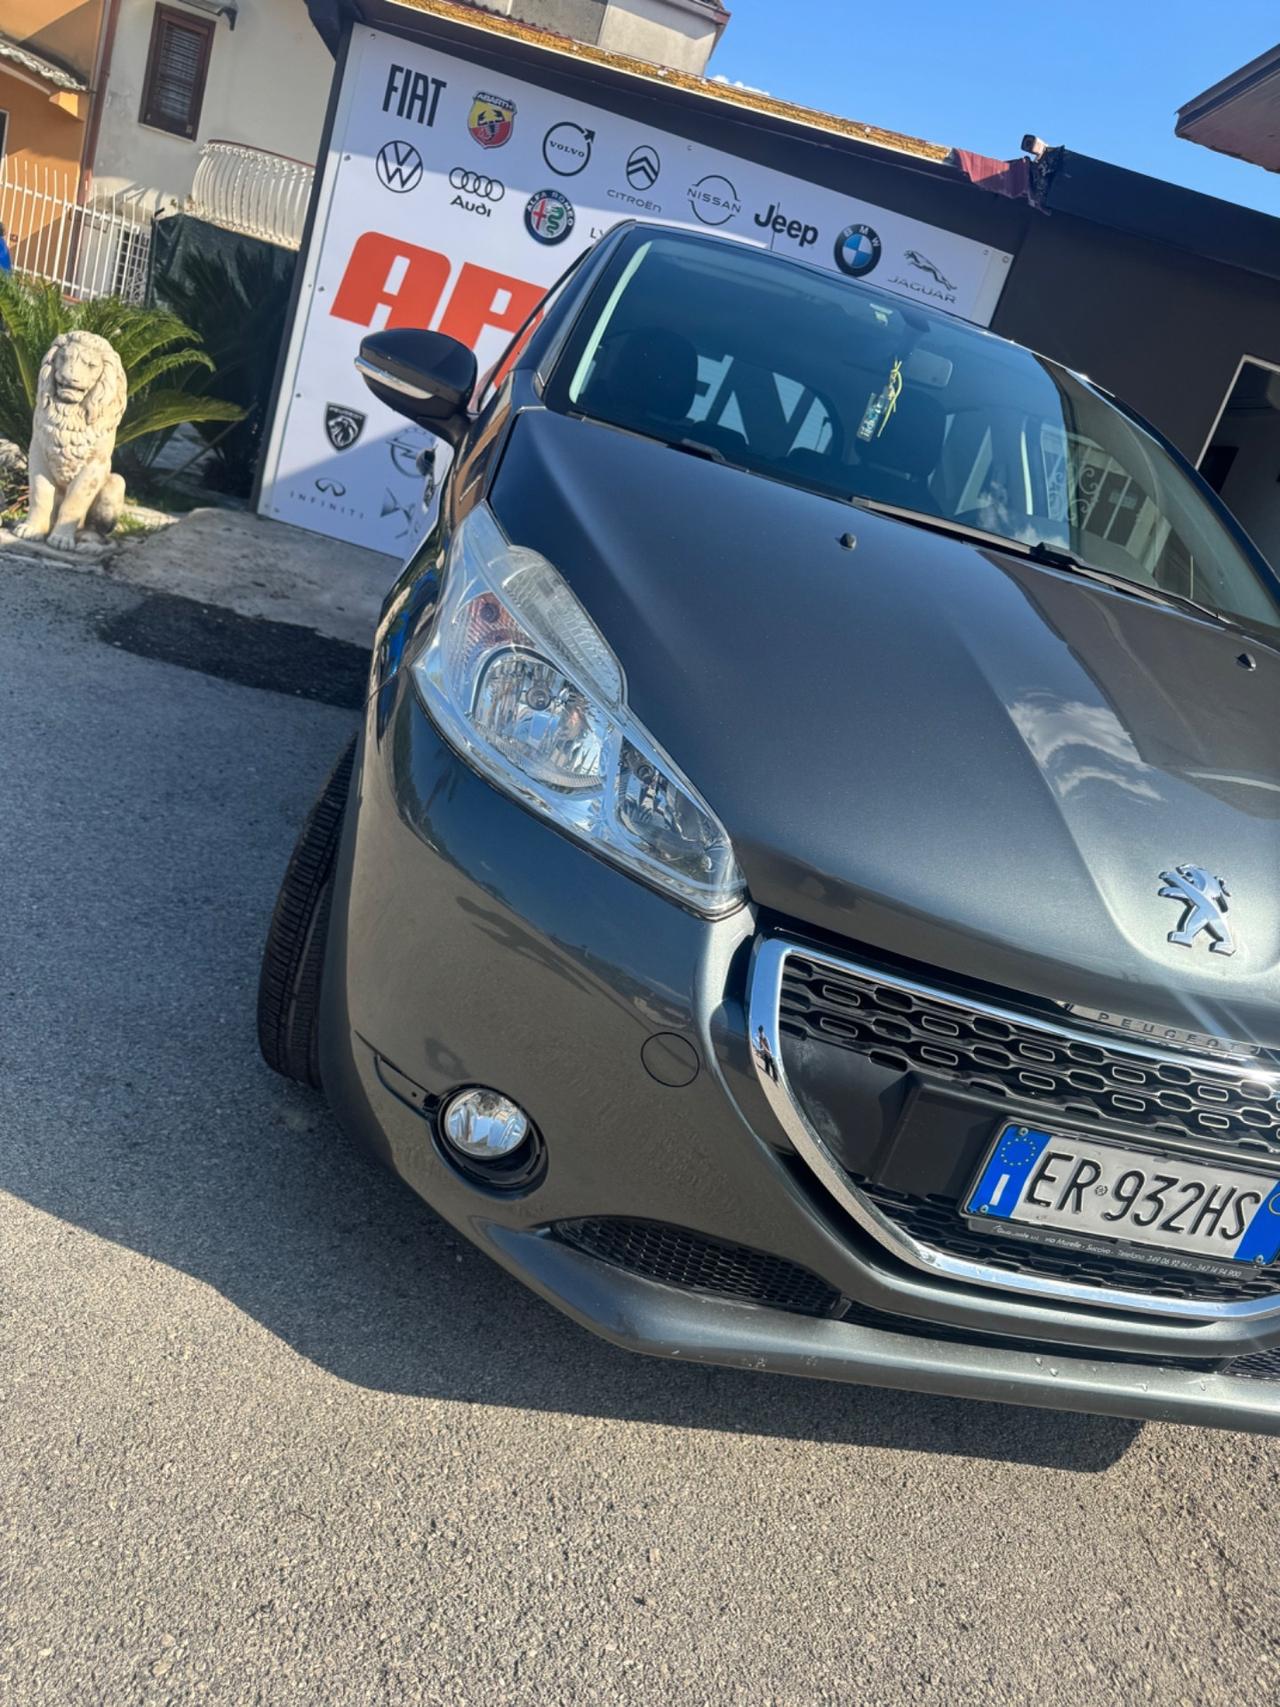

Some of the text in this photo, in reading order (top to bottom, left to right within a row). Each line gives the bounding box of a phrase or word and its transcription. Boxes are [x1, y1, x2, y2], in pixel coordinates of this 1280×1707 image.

[382, 64, 447, 127] FIAT
[549, 140, 585, 158] VOLVO
[450, 194, 492, 218] Audi
[527, 191, 574, 227] ALFA ROMEO
[687, 187, 741, 214] NISSAN
[754, 204, 819, 248] Jeep
[843, 224, 882, 249] BMW
[887, 274, 958, 304] JAGUAR
[290, 490, 365, 520] INFINITI
[1098, 1012, 1241, 1050] PEUGEOT
[1026, 1151, 1262, 1240] ER 932HS
